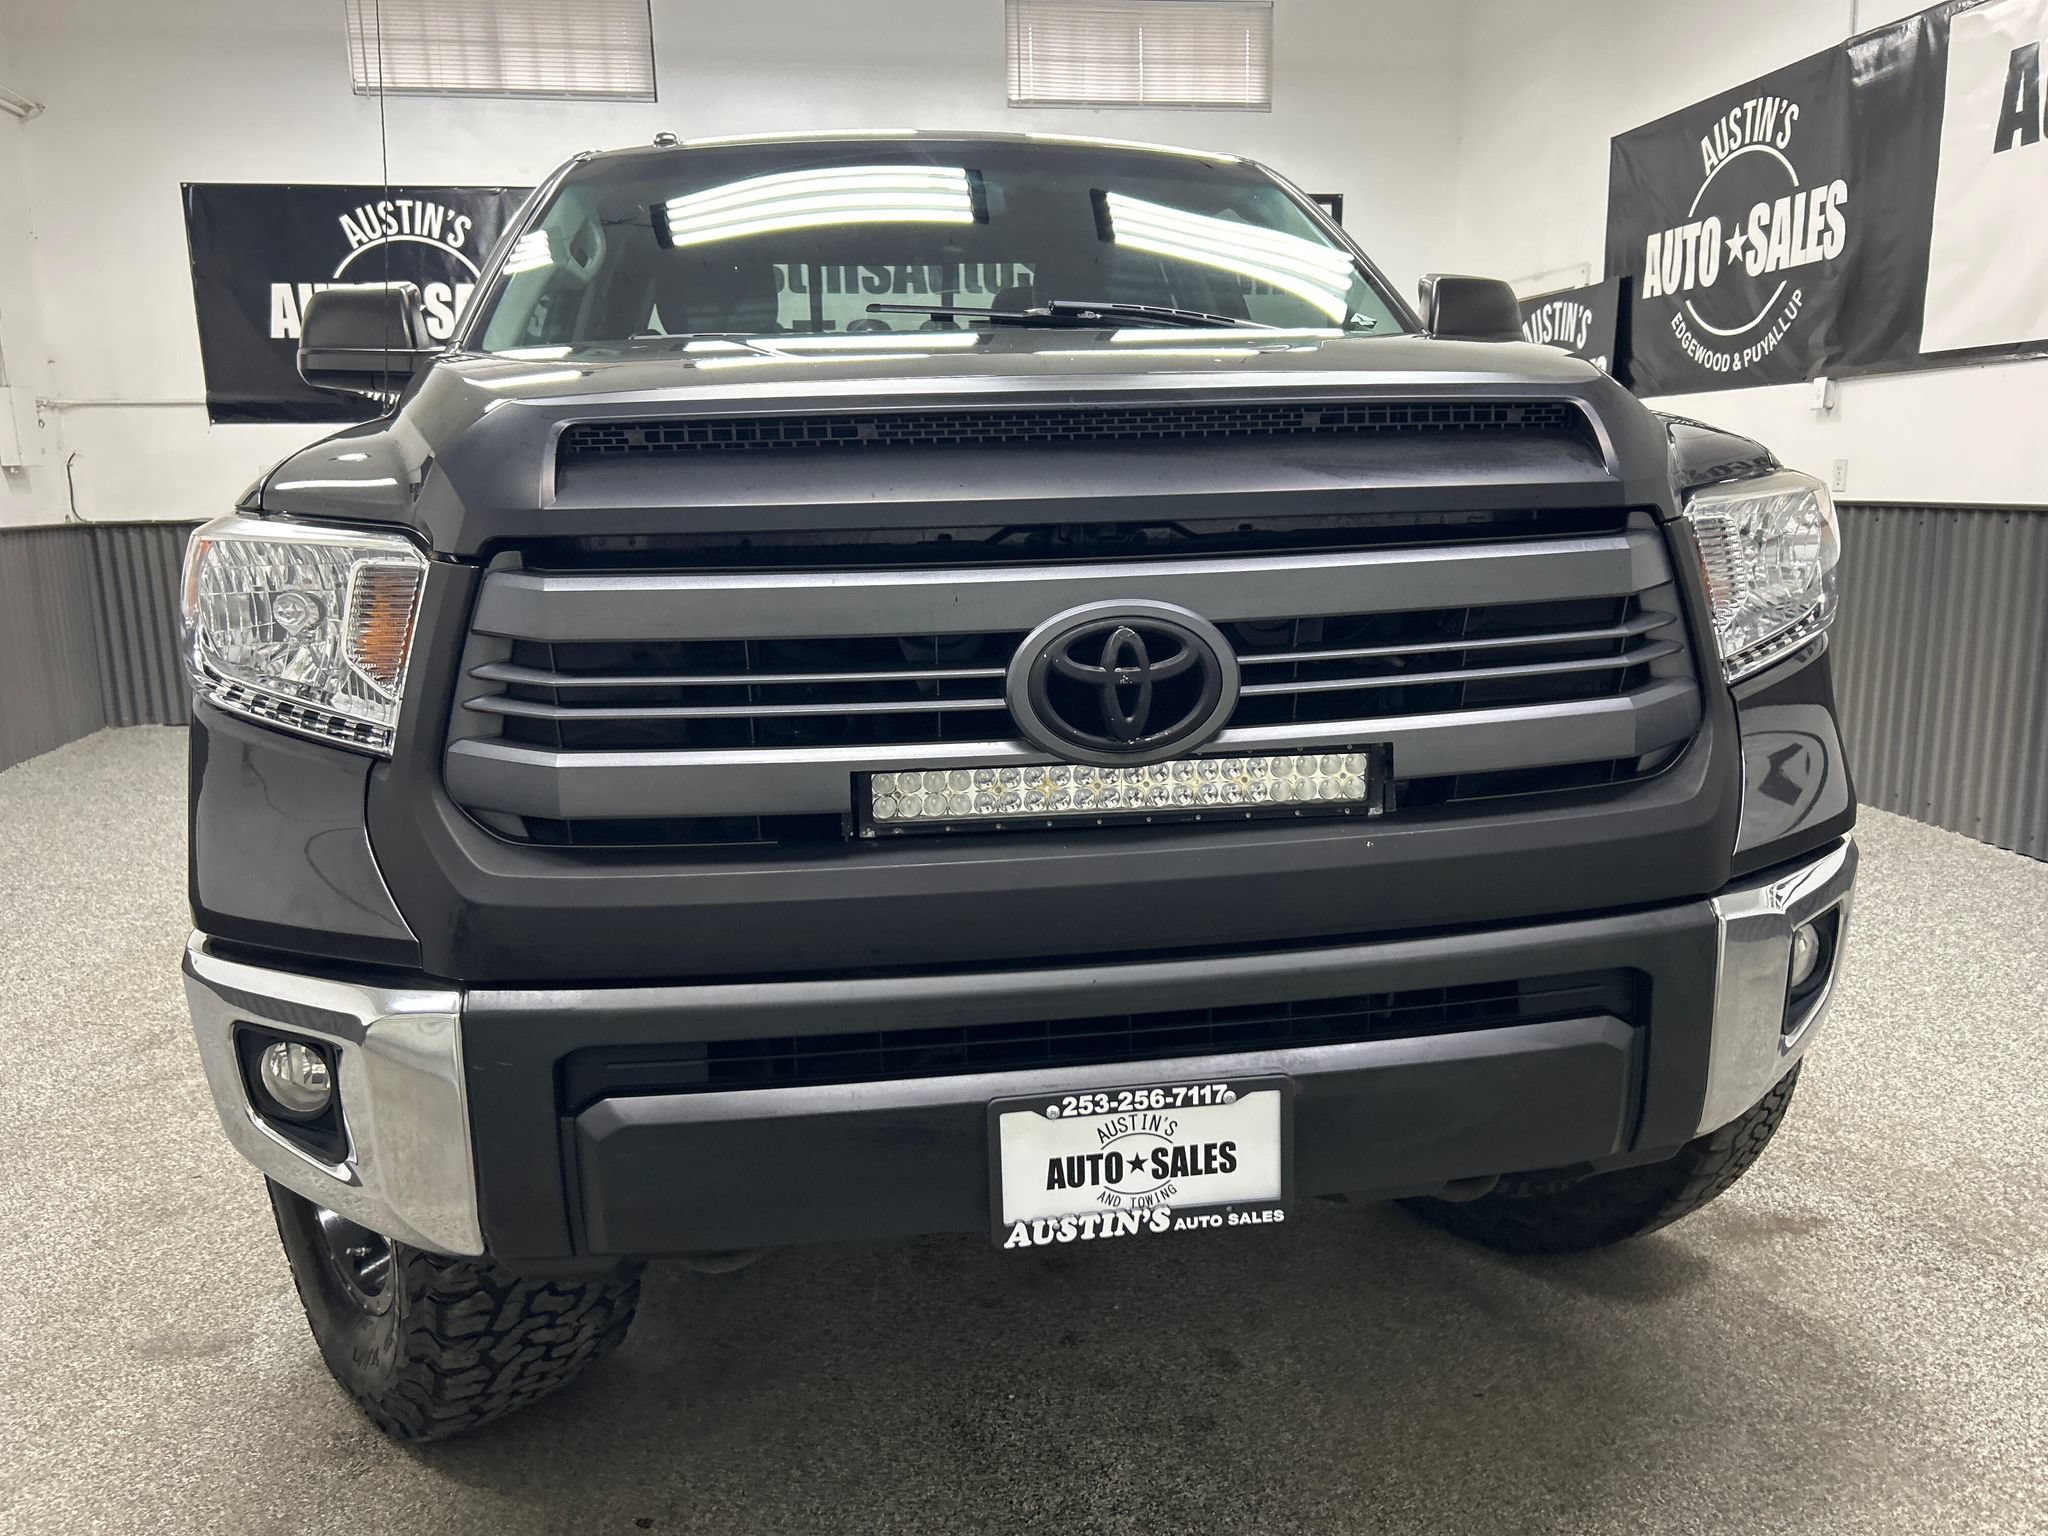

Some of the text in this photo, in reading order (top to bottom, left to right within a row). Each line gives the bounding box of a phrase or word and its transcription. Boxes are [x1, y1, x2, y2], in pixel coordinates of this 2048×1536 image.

[1700, 95, 1800, 177] AUSTIN'S
[338, 199, 472, 250] AUSTIN'S
[1642, 178, 1848, 300] AUTO SALES
[1670, 288, 1803, 372] EDGEWOOD & PUYALLUP
[1061, 1084, 1228, 1118] 253-256-7117
[1096, 1113, 1178, 1144] AUSTIN'S
[1046, 1141, 1238, 1191] AUTO SALES
[1096, 1183, 1178, 1210] AND TOWING
[1003, 1207, 1285, 1250] AUSTIN'S AUTO SALES
